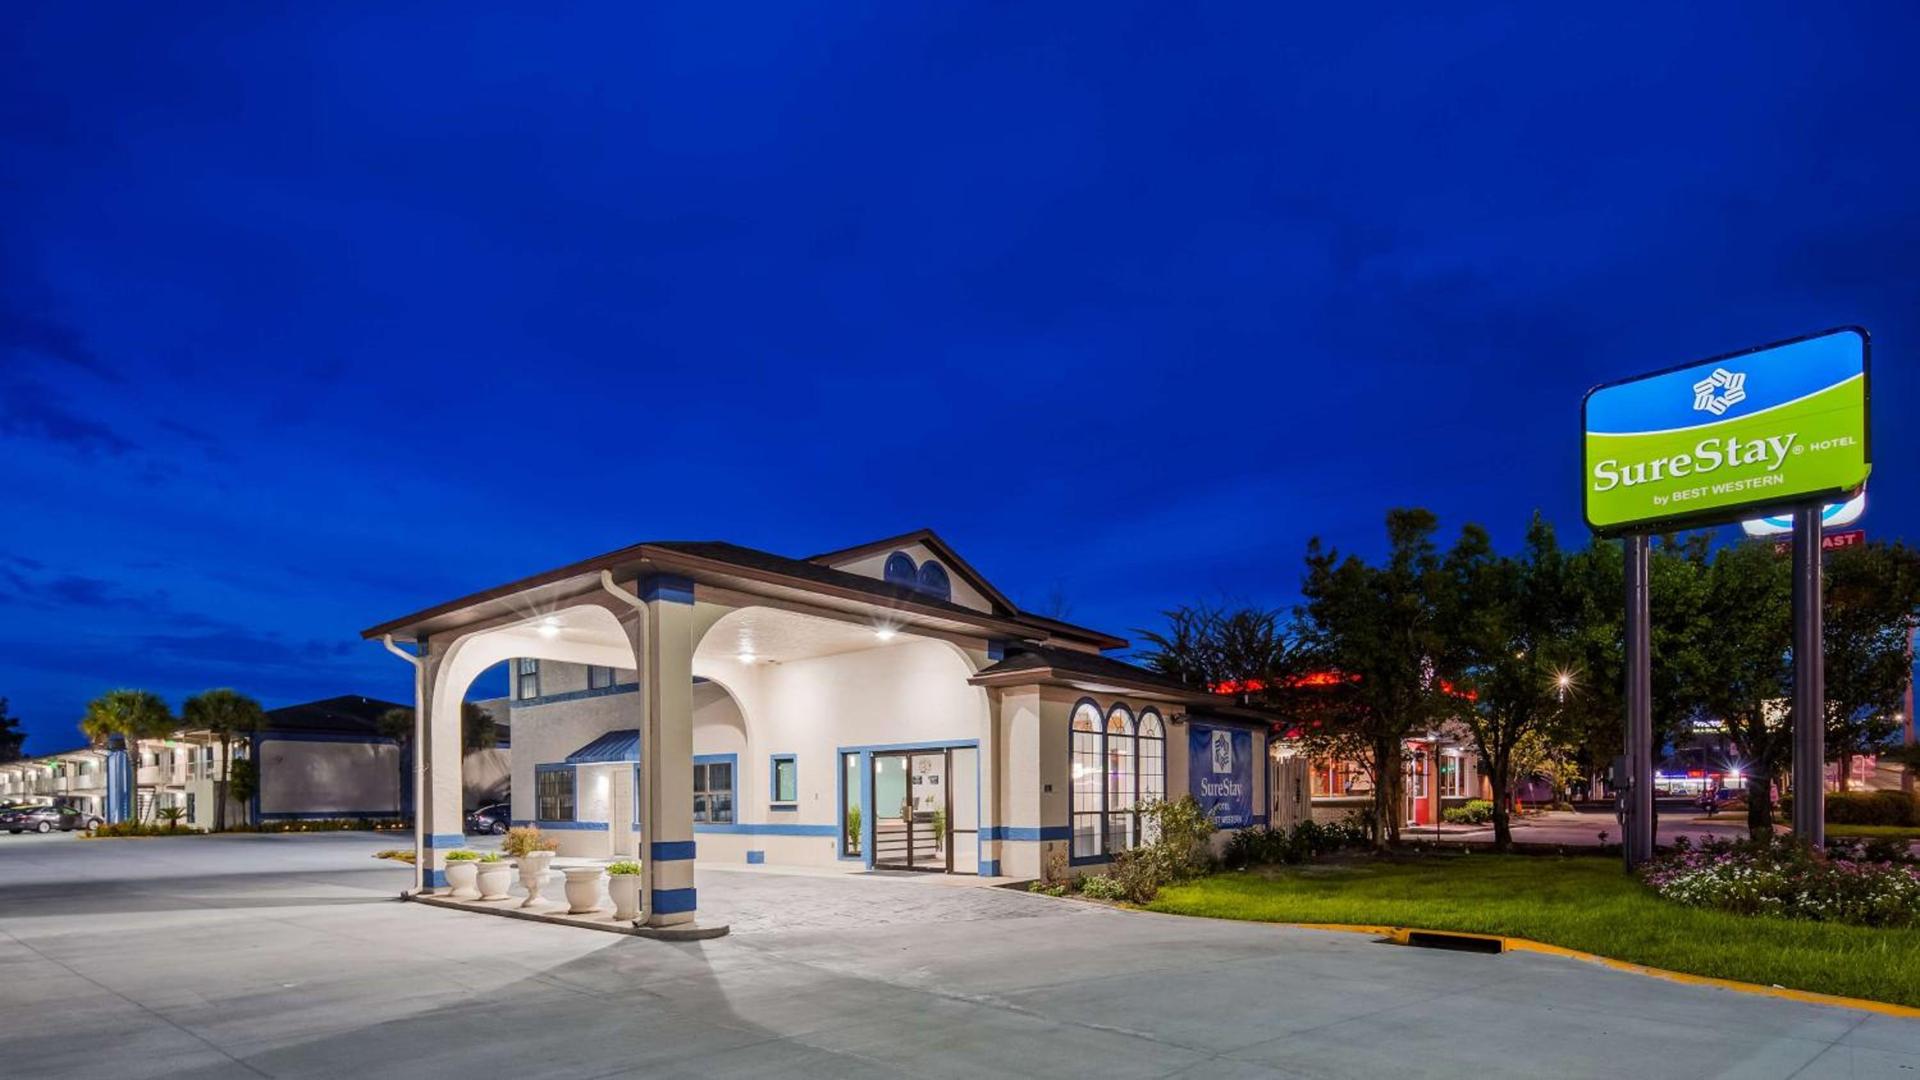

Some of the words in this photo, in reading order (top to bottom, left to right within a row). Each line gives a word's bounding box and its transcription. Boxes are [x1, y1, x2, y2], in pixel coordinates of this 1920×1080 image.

[1809, 436, 1857, 452] HOTEL
[1653, 495, 1669, 506] by
[1672, 487, 1709, 501] BEST
[1712, 474, 1784, 495] WESTERN
[1200, 777, 1243, 802] SureStay
